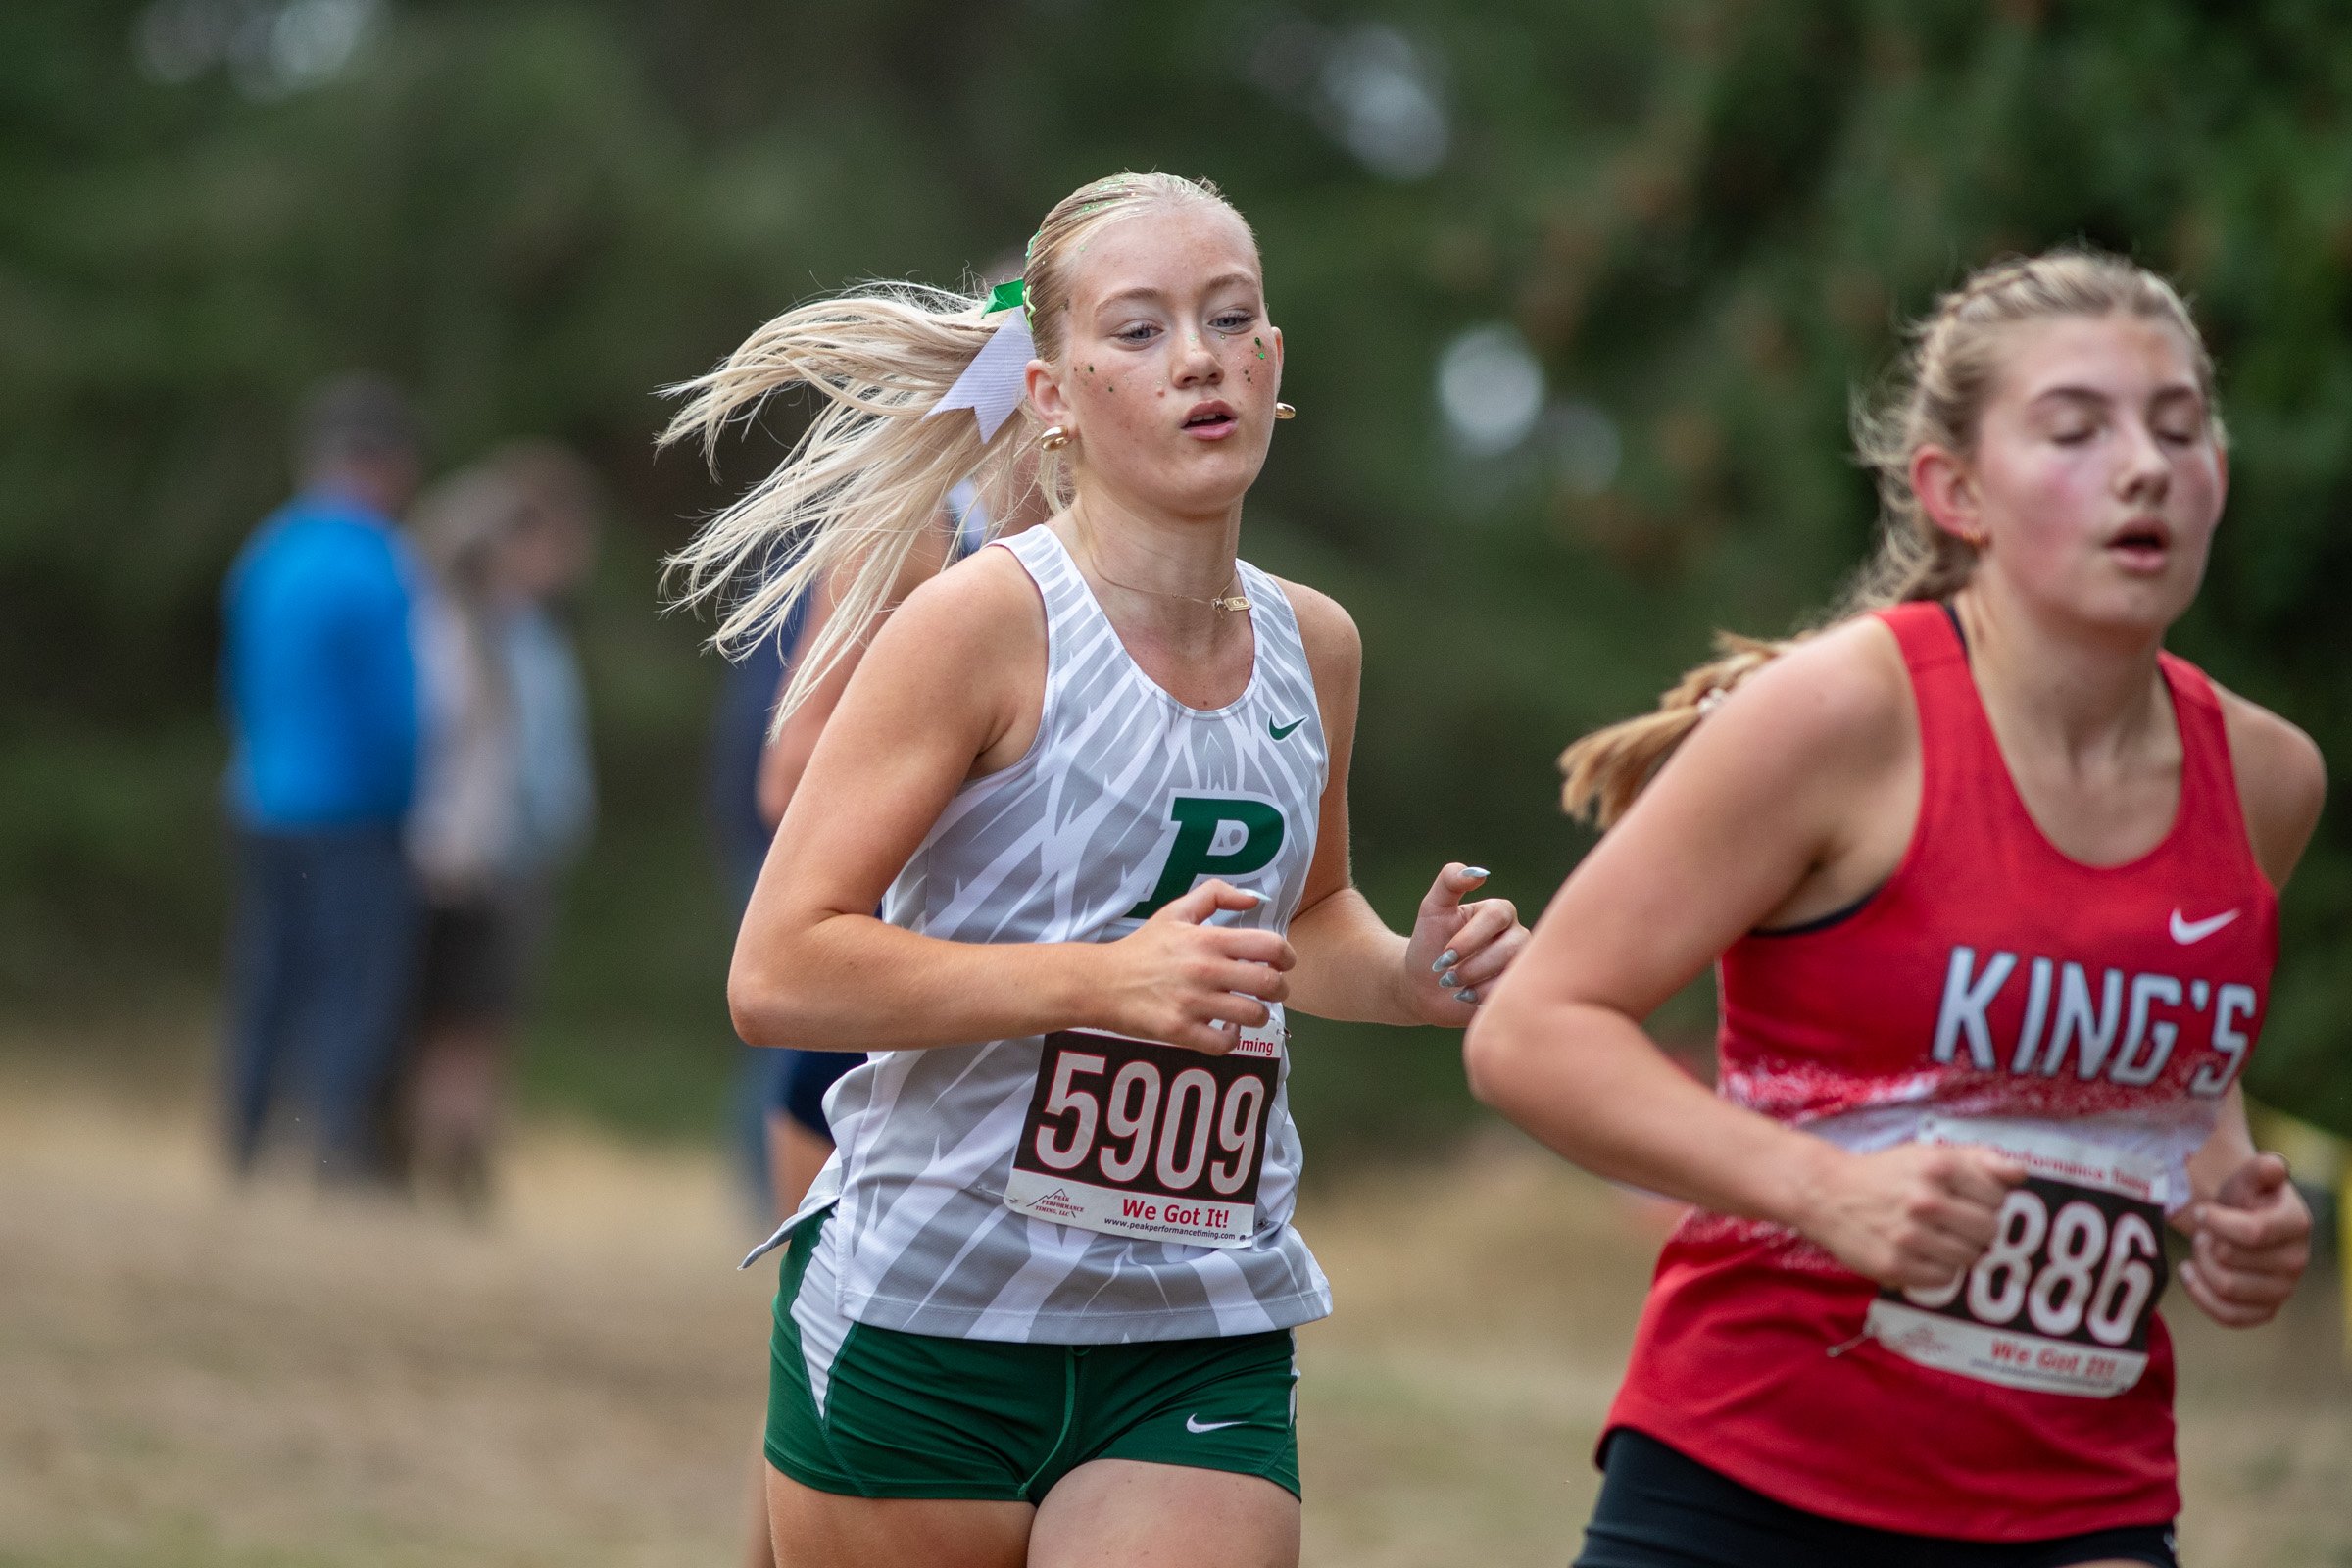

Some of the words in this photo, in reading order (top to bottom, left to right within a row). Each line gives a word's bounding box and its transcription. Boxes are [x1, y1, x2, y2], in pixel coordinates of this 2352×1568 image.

[1123, 796, 1285, 919] P
[1931, 944, 2256, 1096] KING'S
[1236, 1035, 1274, 1057] iming
[1035, 1050, 1265, 1196] 5909
[1041, 1200, 1085, 1212] PERFORMANCE
[1122, 1198, 1156, 1221] We
[1163, 1204, 1200, 1226] Got
[1204, 1208, 1230, 1229] It!
[1103, 1217, 1236, 1241] www.peakperformancetiming.com
[1902, 1189, 2157, 1347] 886
[1990, 1339, 2031, 1364] We
